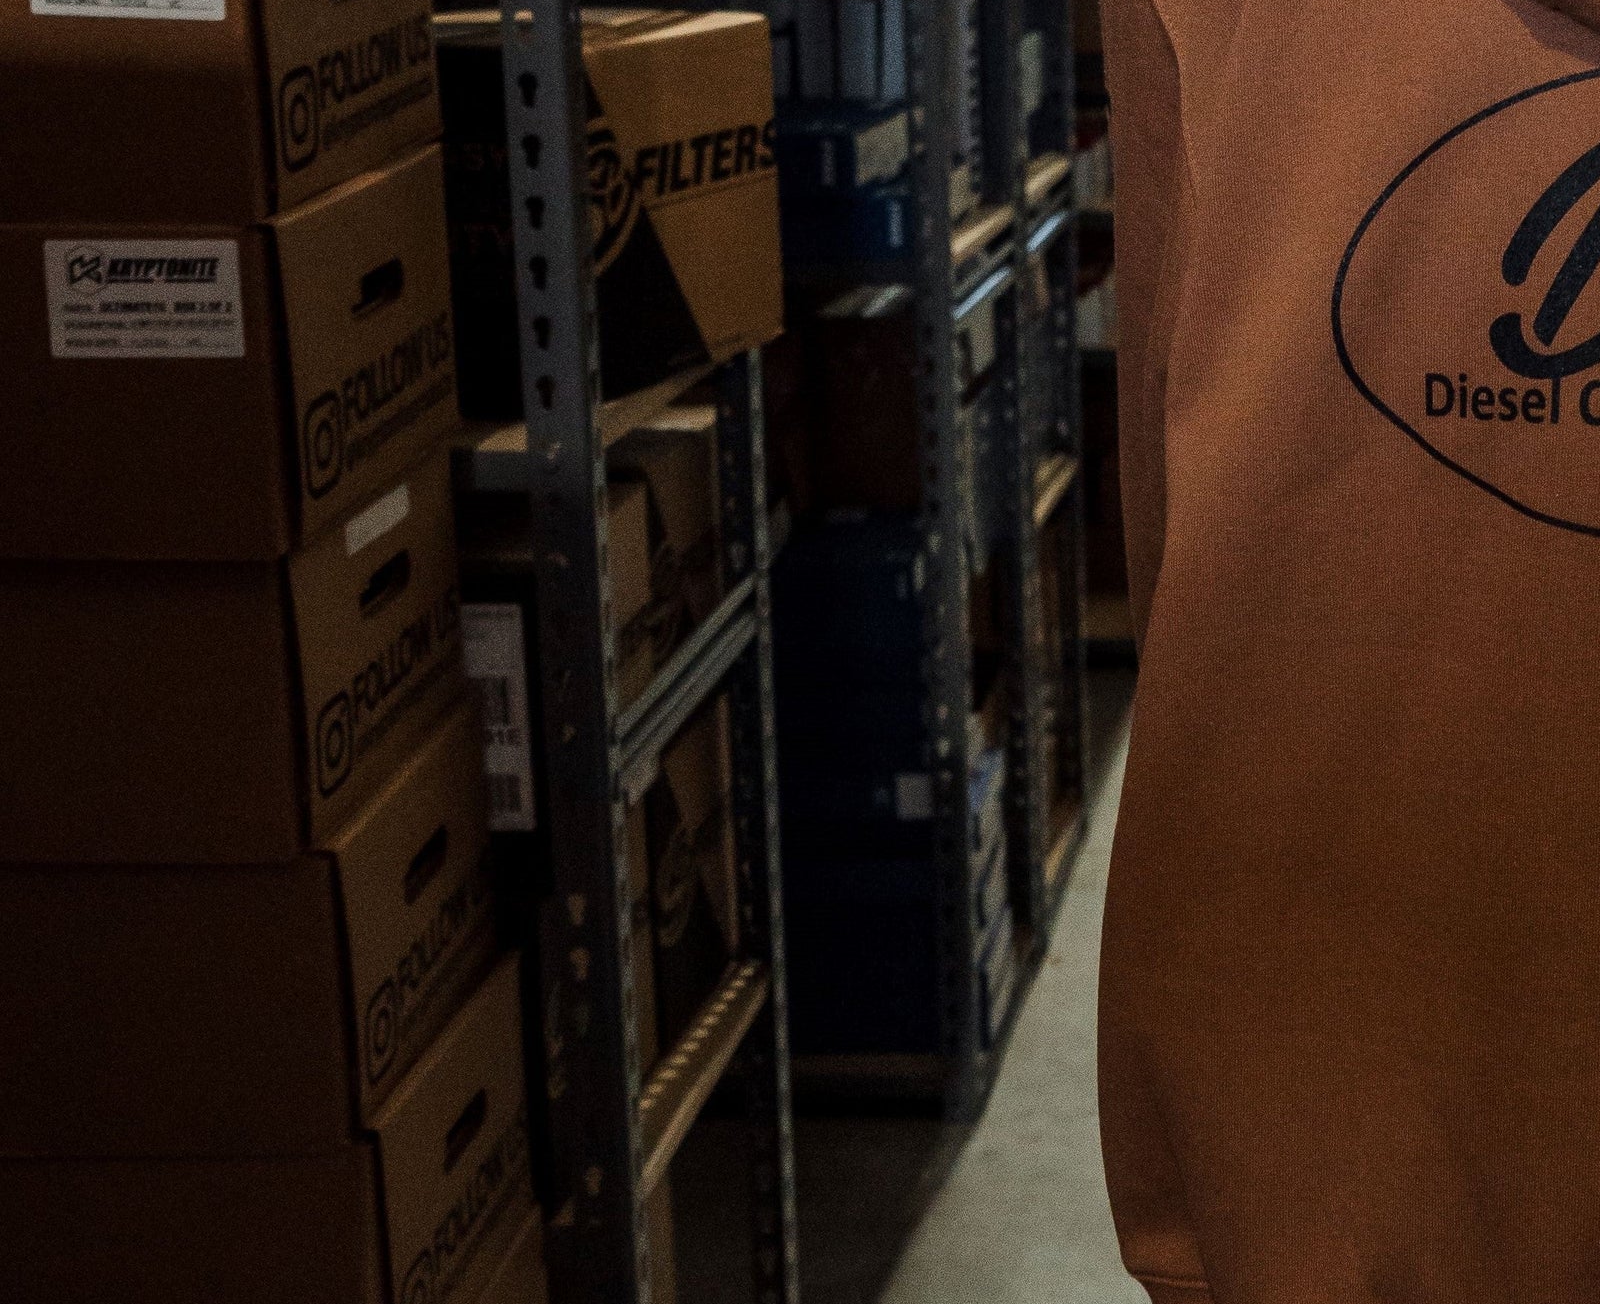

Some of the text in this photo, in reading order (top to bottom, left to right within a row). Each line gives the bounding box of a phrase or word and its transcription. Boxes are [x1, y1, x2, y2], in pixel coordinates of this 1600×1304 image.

[318, 25, 401, 109] FOLLOW
[630, 118, 778, 195] FILTERS
[107, 257, 219, 281] KRYPTONITE
[343, 327, 424, 429] FOLLOW
[1425, 373, 1562, 424] Diesel
